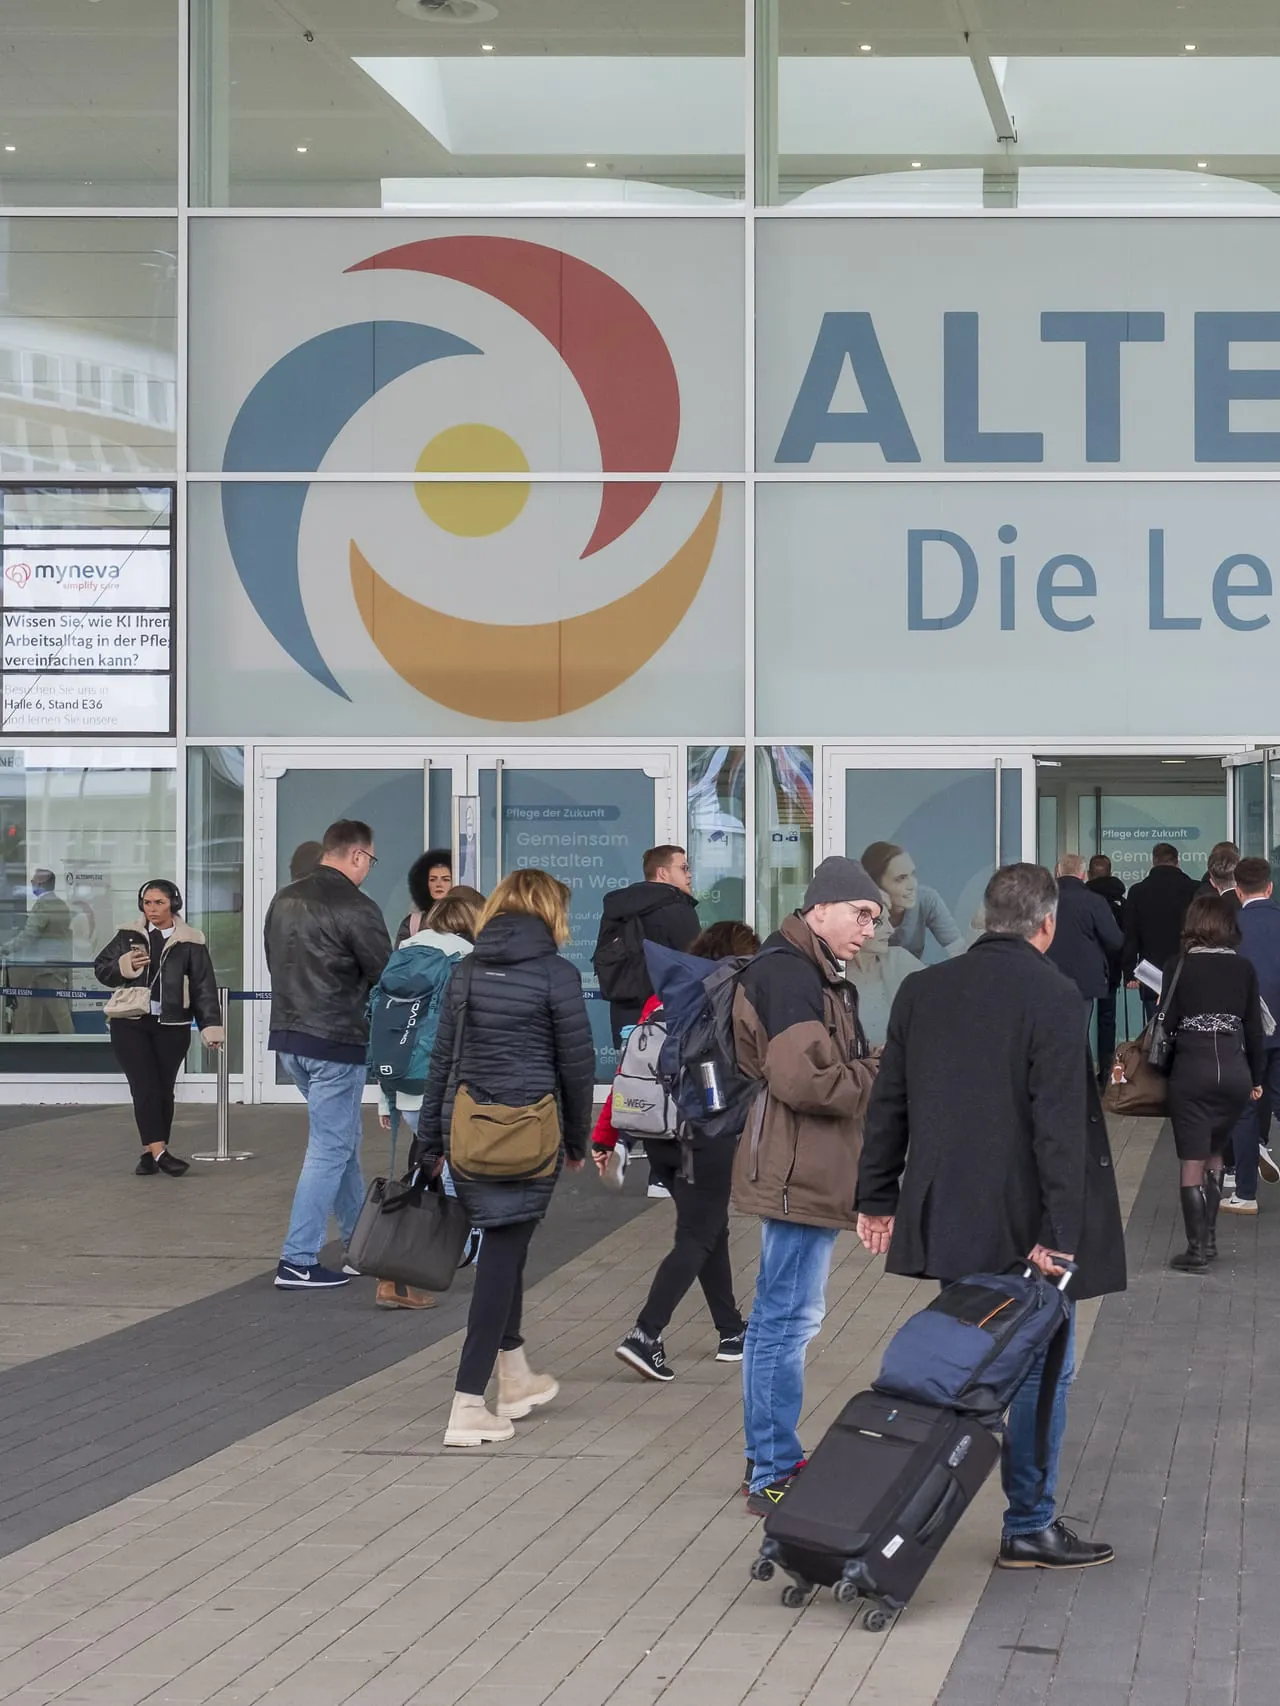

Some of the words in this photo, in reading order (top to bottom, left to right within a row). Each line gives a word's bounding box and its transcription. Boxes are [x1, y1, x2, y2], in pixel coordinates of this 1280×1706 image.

[35, 563, 120, 584] myneva
[907, 523, 1098, 632] Die
[63, 581, 98, 591] simplify
[5, 615, 56, 628] Wissen
[60, 615, 84, 629] Sie,
[88, 615, 113, 628] wie
[116, 615, 132, 628] KI
[5, 634, 93, 650] Arbeitsalltag
[97, 634, 110, 647] in
[113, 634, 137, 647] der
[140, 634, 170, 648] Pfle
[5, 653, 94, 667] vereinfachen
[98, 653, 139, 667] kann?
[4, 699, 33, 710] Halle
[35, 699, 46, 711] 6,
[48, 699, 79, 710] Stand
[82, 699, 103, 710] E36
[506, 808, 540, 820] Pflege
[542, 808, 561, 818] der
[563, 808, 605, 818] Zukunft
[516, 831, 629, 846] Gemeinsam
[1102, 829, 1132, 840] Pflege
[1133, 829, 1150, 838] der
[1151, 829, 1188, 838] Zukunft
[516, 853, 604, 869] gestalten
